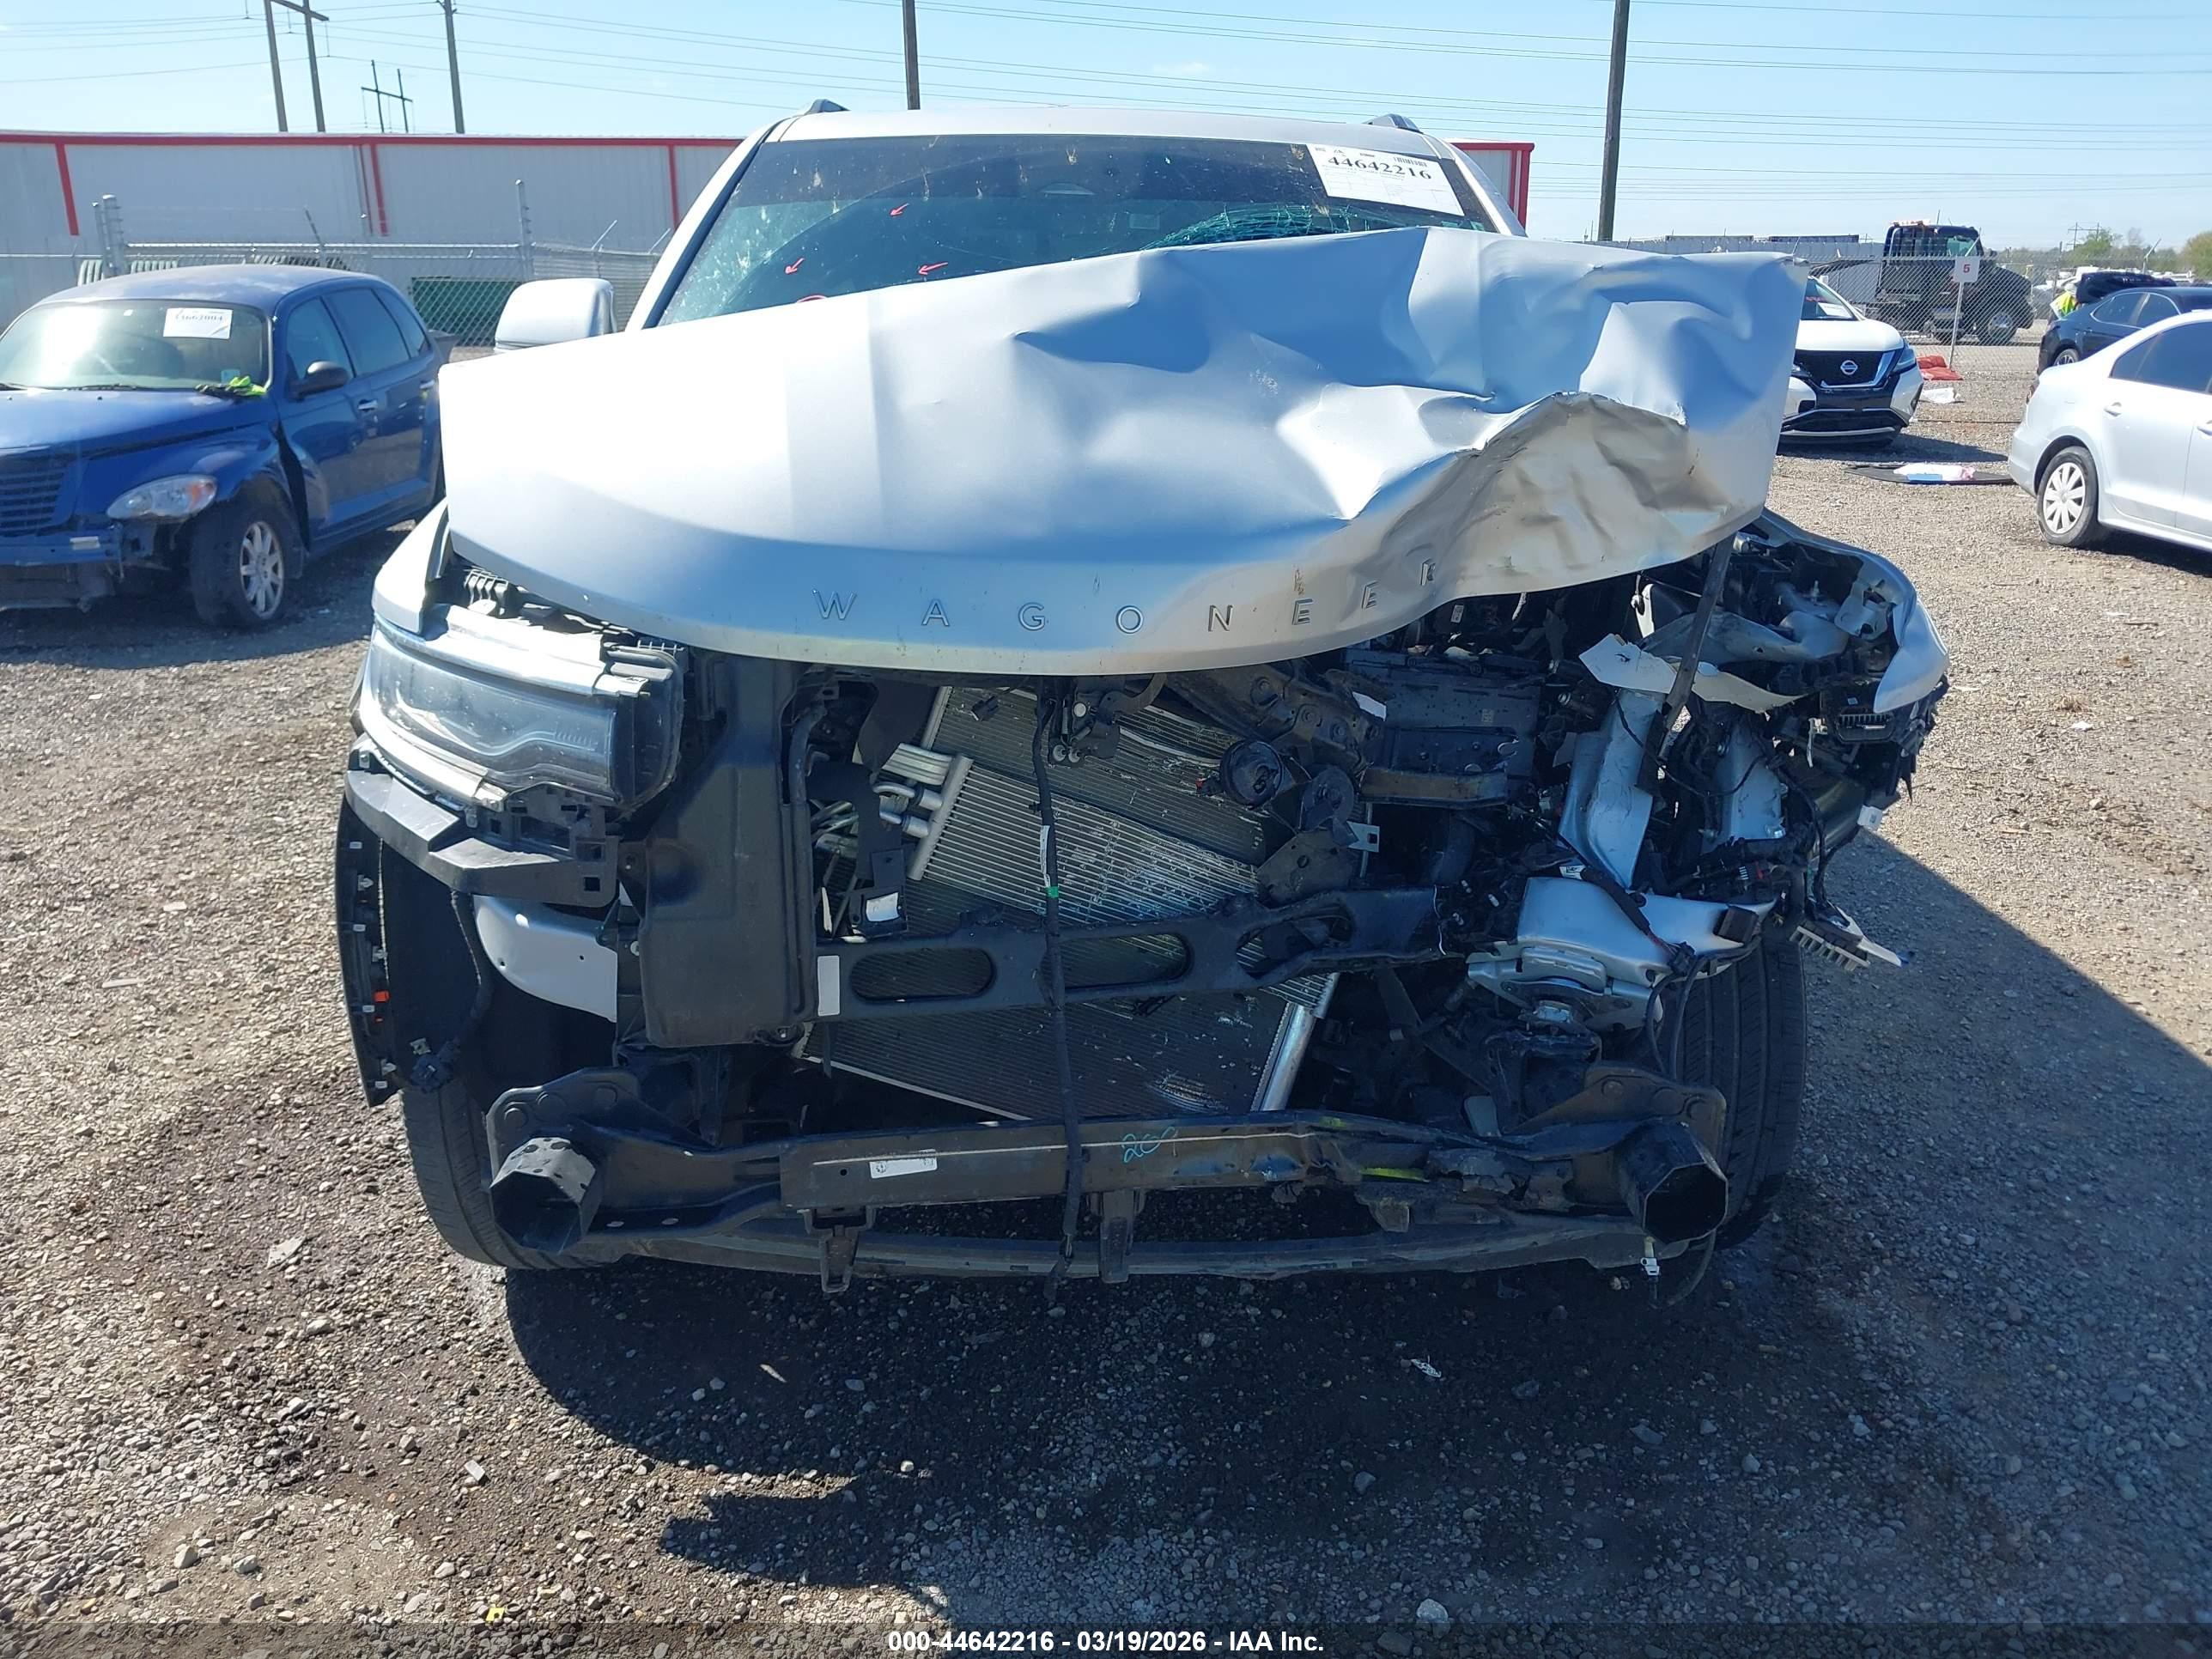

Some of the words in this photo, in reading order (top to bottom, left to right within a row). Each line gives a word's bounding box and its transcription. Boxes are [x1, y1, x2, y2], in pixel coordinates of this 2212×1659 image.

[1328, 155, 1432, 180] 44642216
[1963, 264, 1971, 273] 5
[812, 558, 1437, 636] WAGONEER
